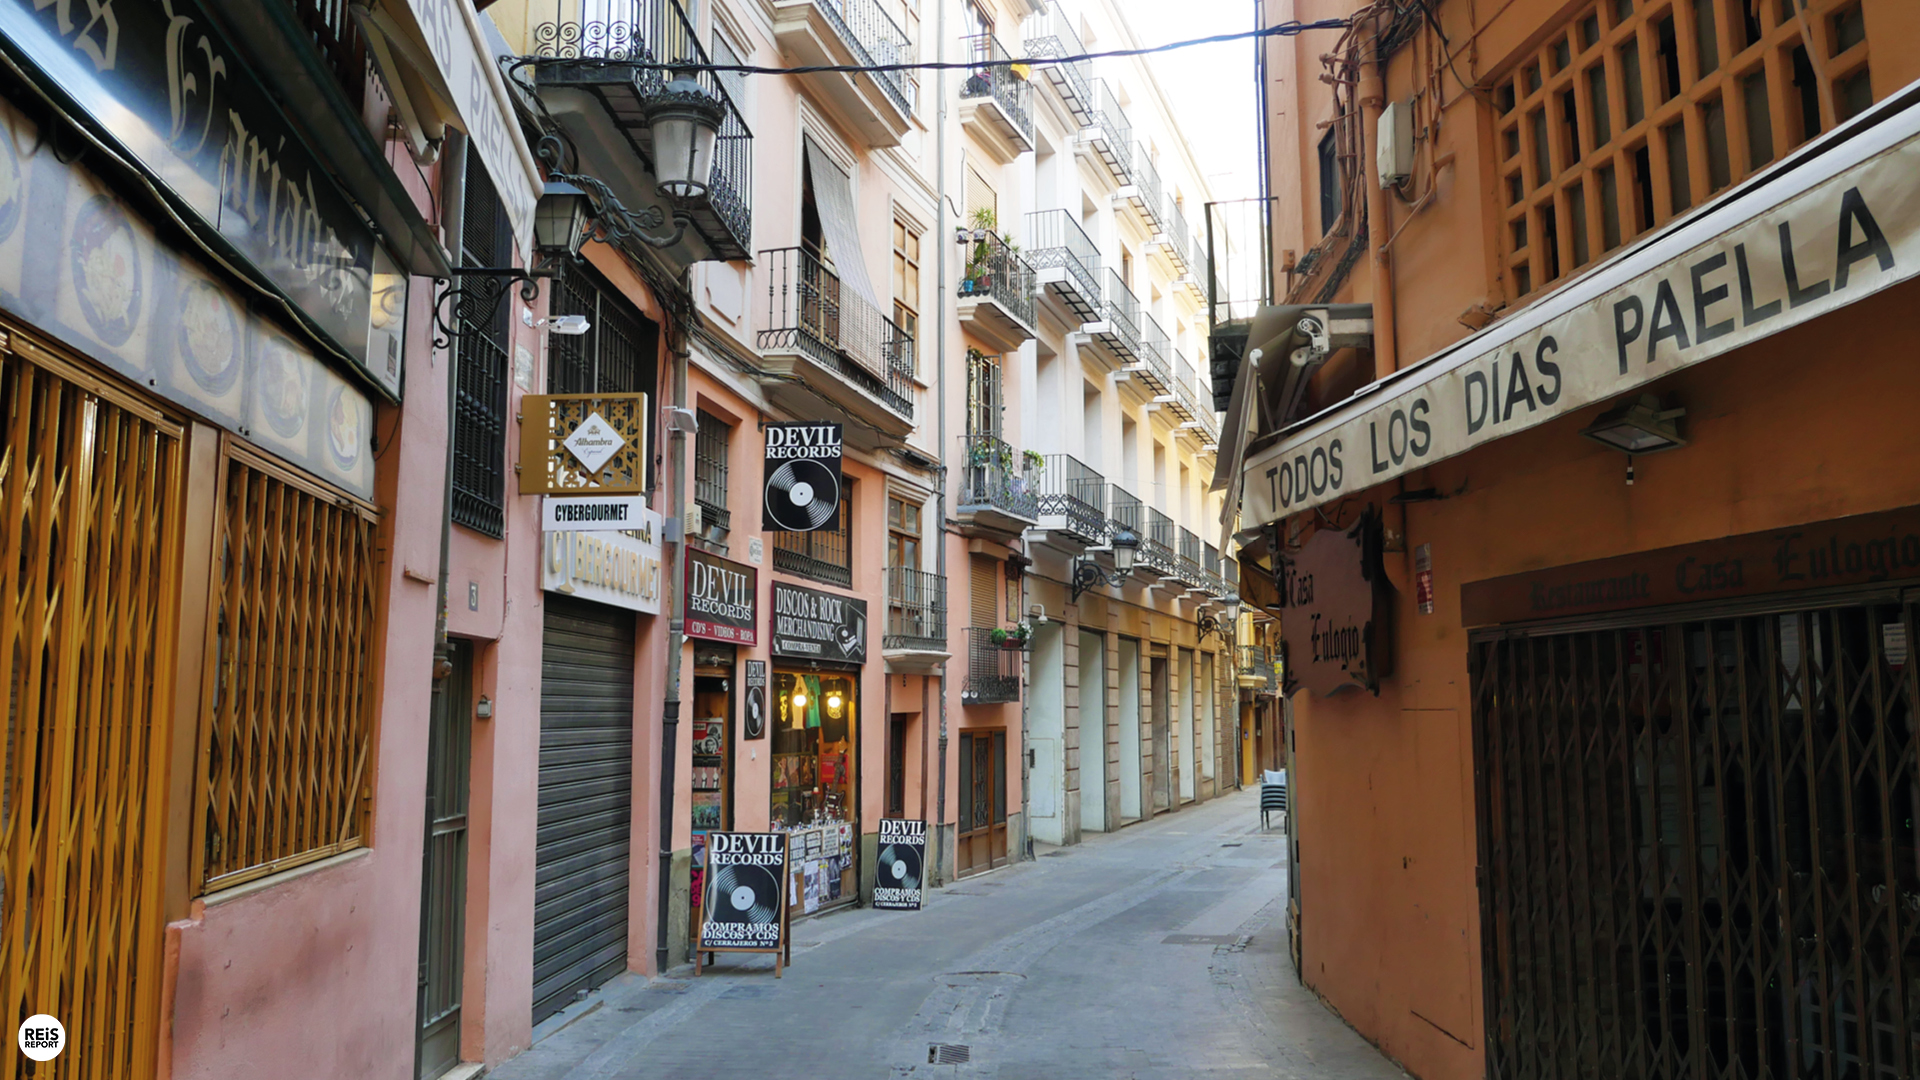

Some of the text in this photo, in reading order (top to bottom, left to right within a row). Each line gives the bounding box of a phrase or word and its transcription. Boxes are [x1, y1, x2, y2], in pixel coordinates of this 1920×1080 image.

[469, 58, 529, 244] PAELLA
[1266, 186, 1896, 513] TODOS LOS DÍAS PAELLA
[574, 437, 613, 447] Alhambra
[766, 426, 841, 447] DEVIL
[765, 446, 841, 459] RECORDS
[555, 504, 628, 522] CYBERGOURMET
[691, 560, 752, 609] DEVIL
[1675, 555, 1744, 594] Casa
[471, 585, 477, 607] 3
[1286, 568, 1313, 608] Casa
[691, 596, 752, 621] RECORDS
[776, 587, 843, 624] DISCOS & ROCK
[776, 615, 835, 642] MERCHANDISING
[1311, 612, 1360, 671] Eulogio
[748, 661, 765, 677] DEVIL
[881, 820, 925, 836] DEVIL
[711, 833, 784, 854] DEVIL
[880, 835, 925, 845] RECORDS
[710, 853, 783, 866] RECORDS
[874, 887, 921, 896] COMPRAMOS
[703, 921, 779, 932] COMPRAMOS
[703, 930, 779, 941] DISCOS Y CDS
